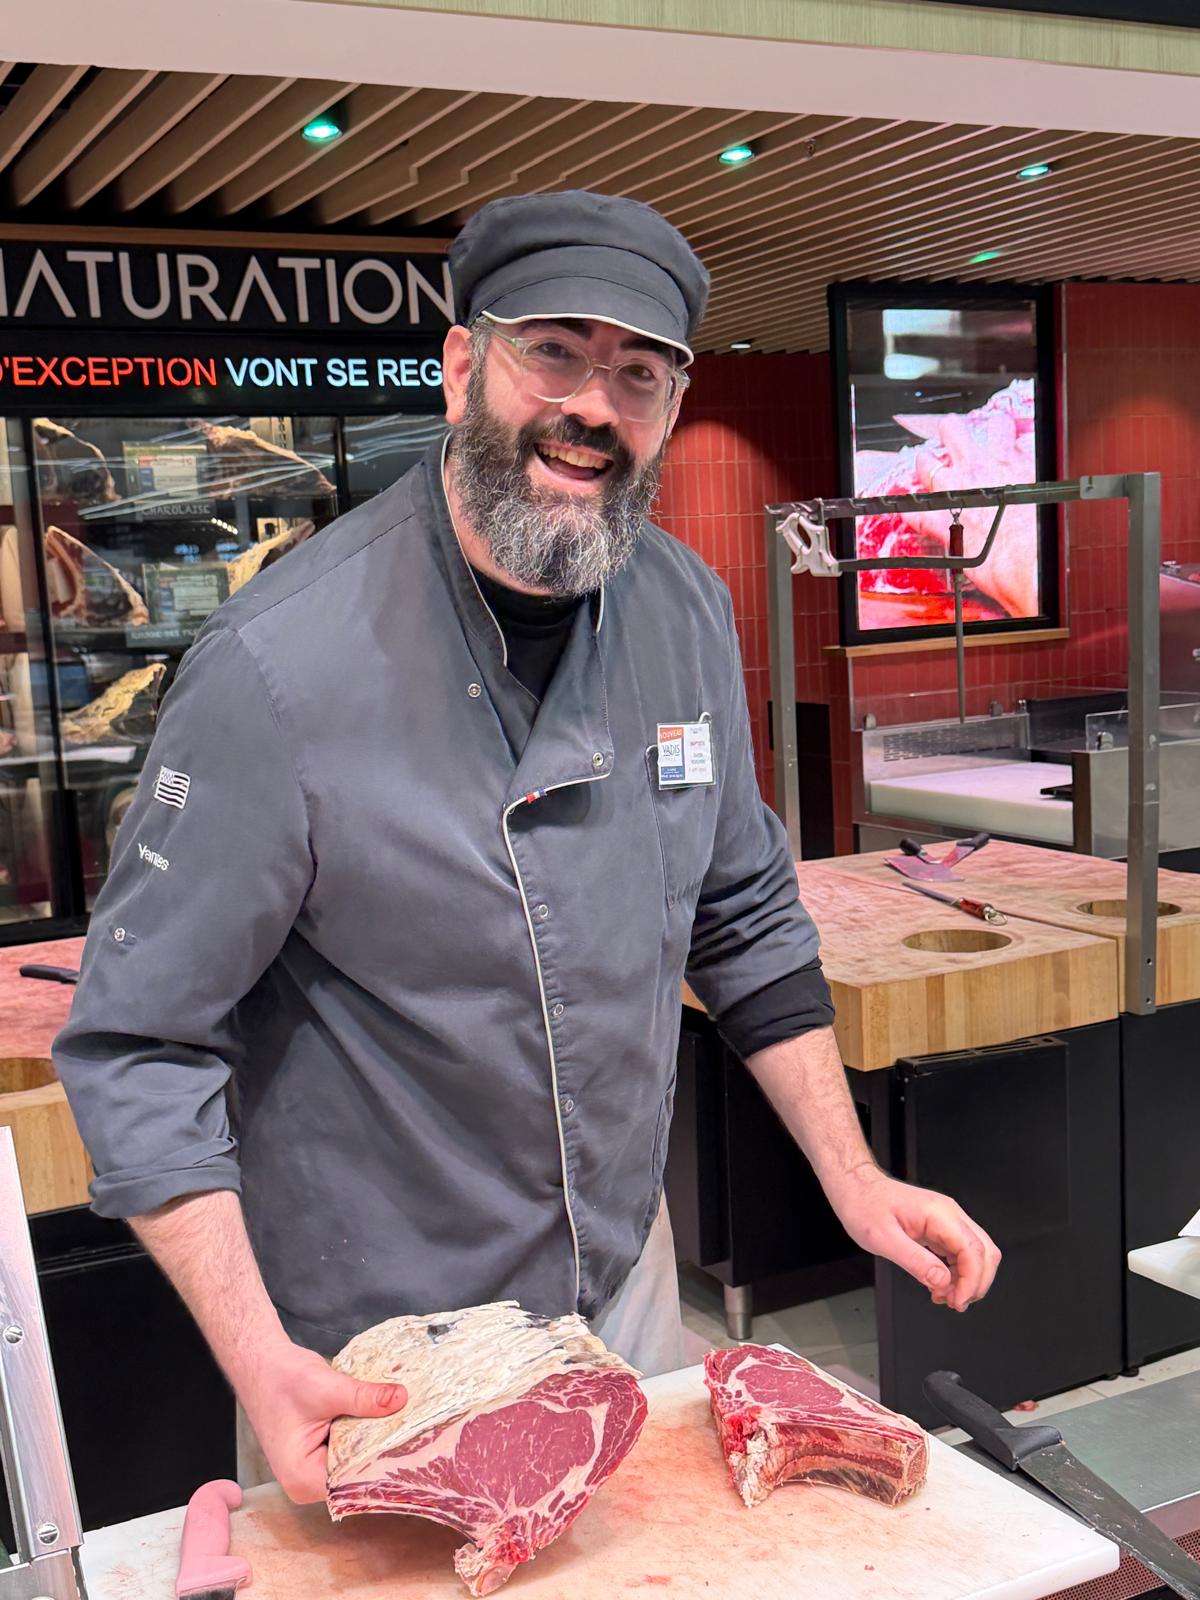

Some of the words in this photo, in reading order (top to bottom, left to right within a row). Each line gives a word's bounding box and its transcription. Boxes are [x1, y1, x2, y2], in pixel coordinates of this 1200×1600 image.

[0, 247, 456, 325] ATURATION
[0, 356, 218, 387] 'EXCEPTION
[224, 357, 318, 387] VONT
[326, 358, 370, 387] SE
